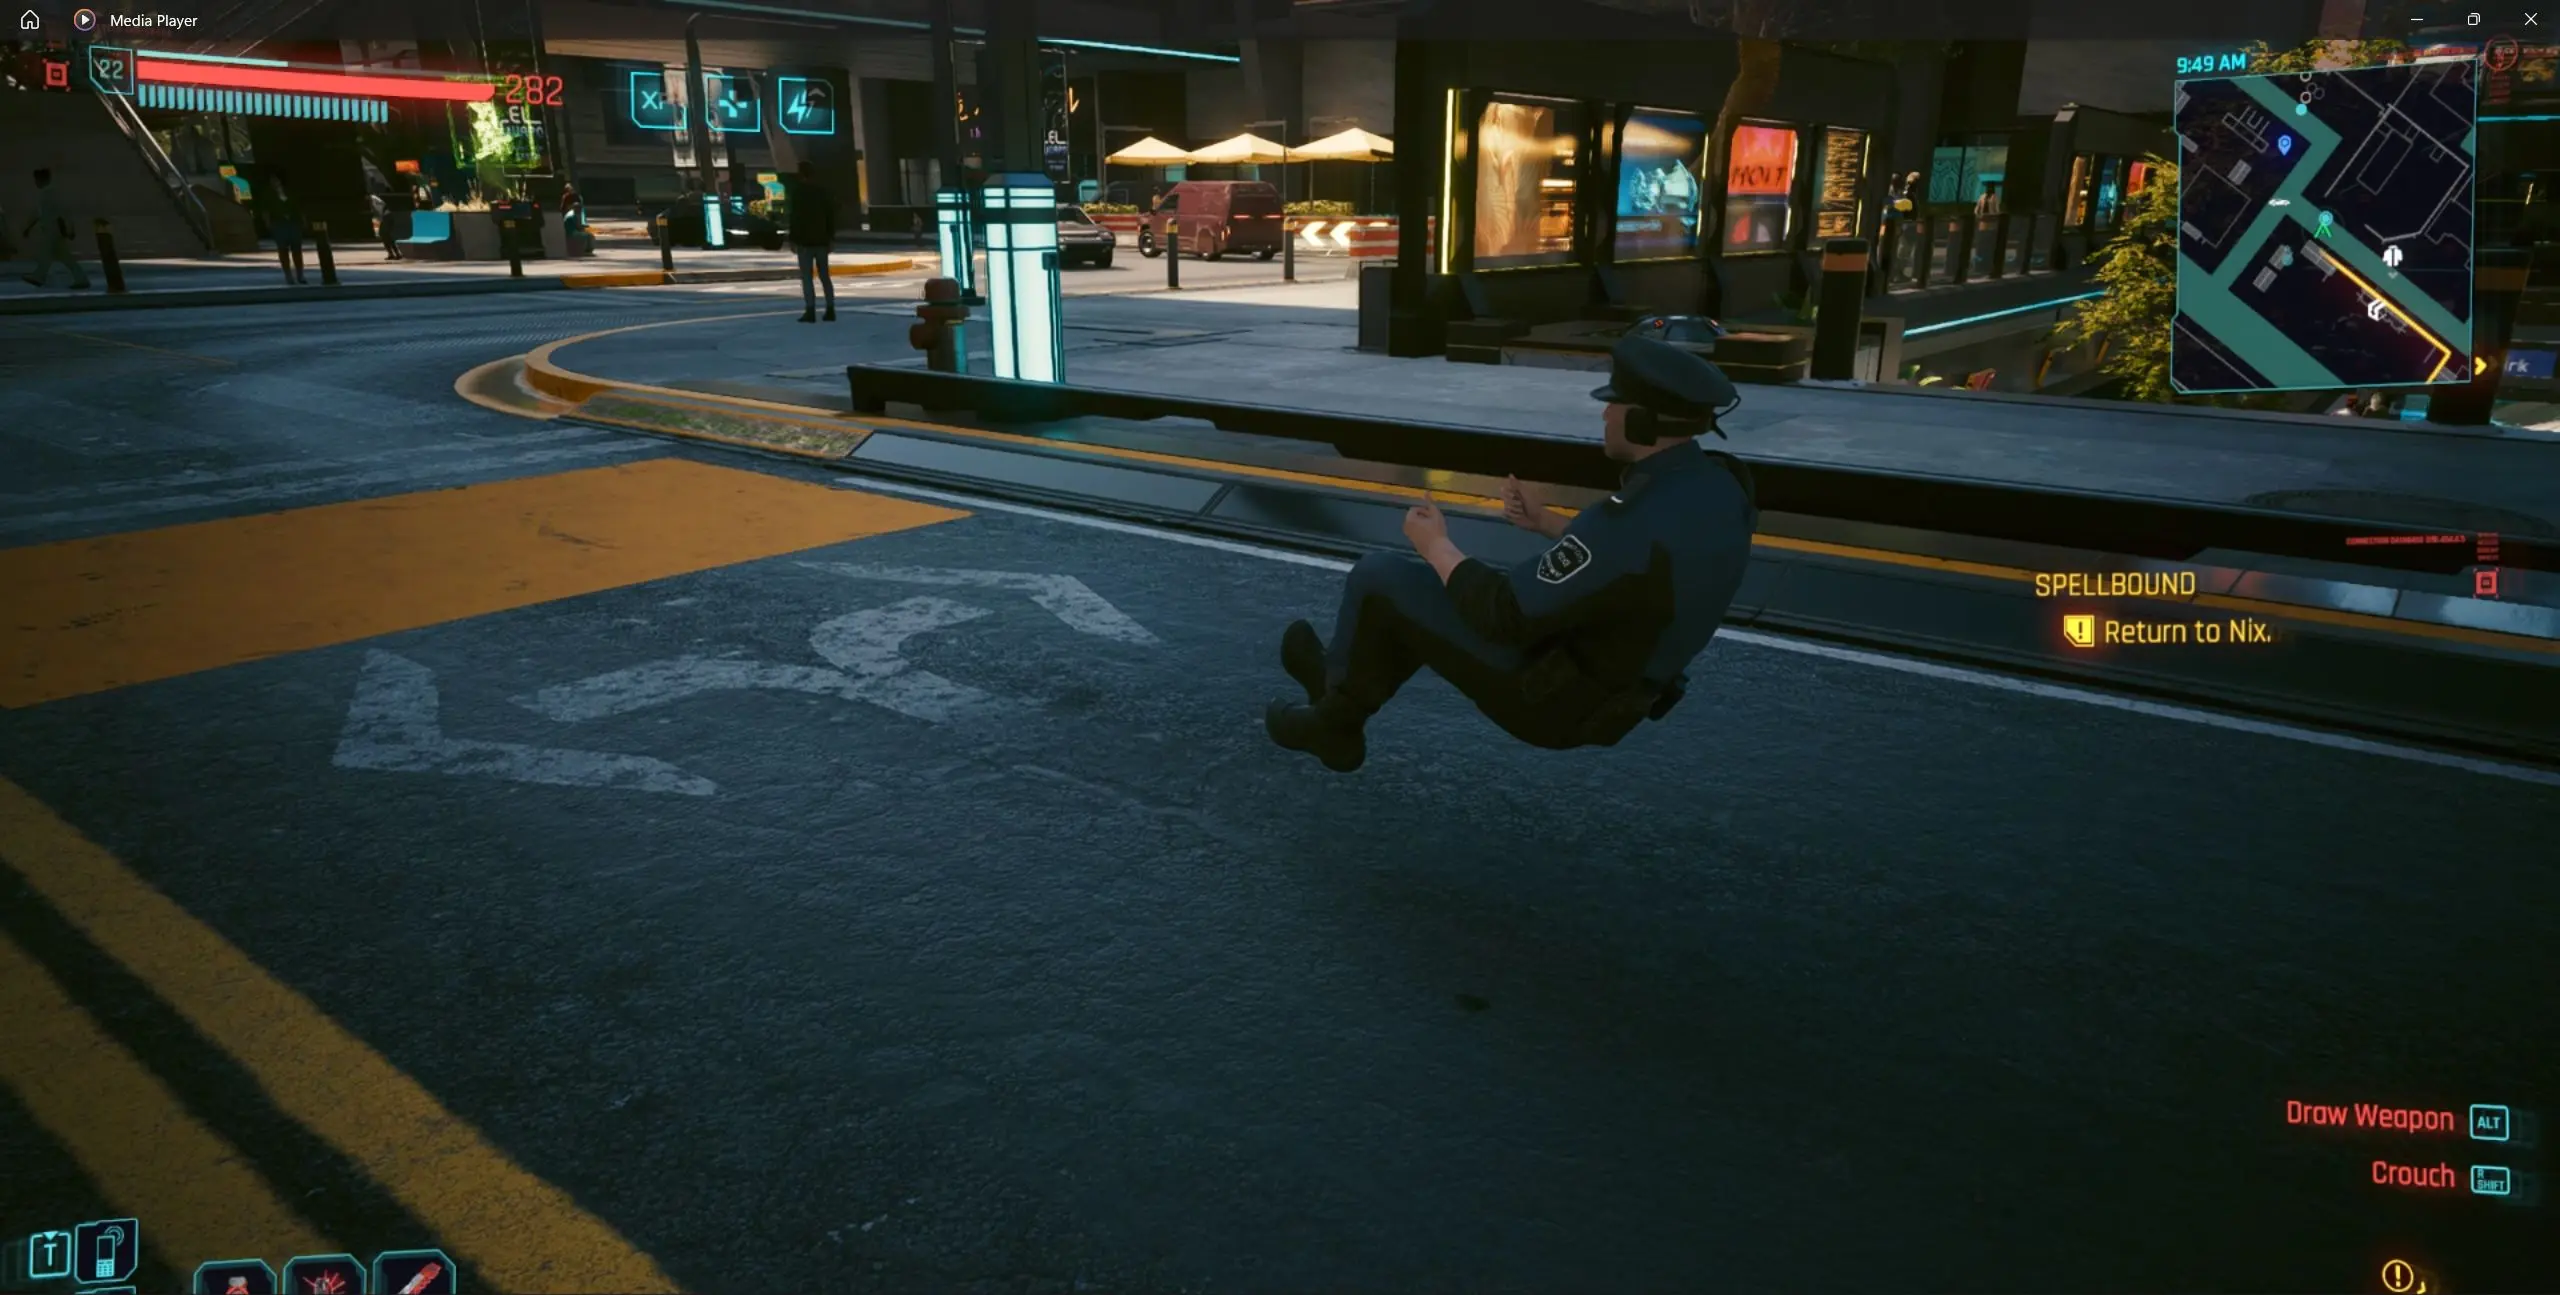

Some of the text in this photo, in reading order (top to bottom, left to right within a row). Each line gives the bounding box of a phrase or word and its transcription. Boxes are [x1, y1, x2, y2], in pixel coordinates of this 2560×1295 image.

[110, 14, 199, 30] Media Player
[99, 59, 124, 79] 22
[2176, 53, 2247, 74] 9:49 AM
[505, 73, 564, 106] 282
[2035, 571, 2196, 597] SPELLBOUND
[2105, 617, 2272, 644] Return to Nix.
[2287, 1100, 2455, 1134] Draw Weapon
[2477, 1115, 2501, 1130] ALT
[2372, 1160, 2456, 1188] Crouch
[2477, 1180, 2505, 1191] SHIFT
[43, 1243, 58, 1267] T
